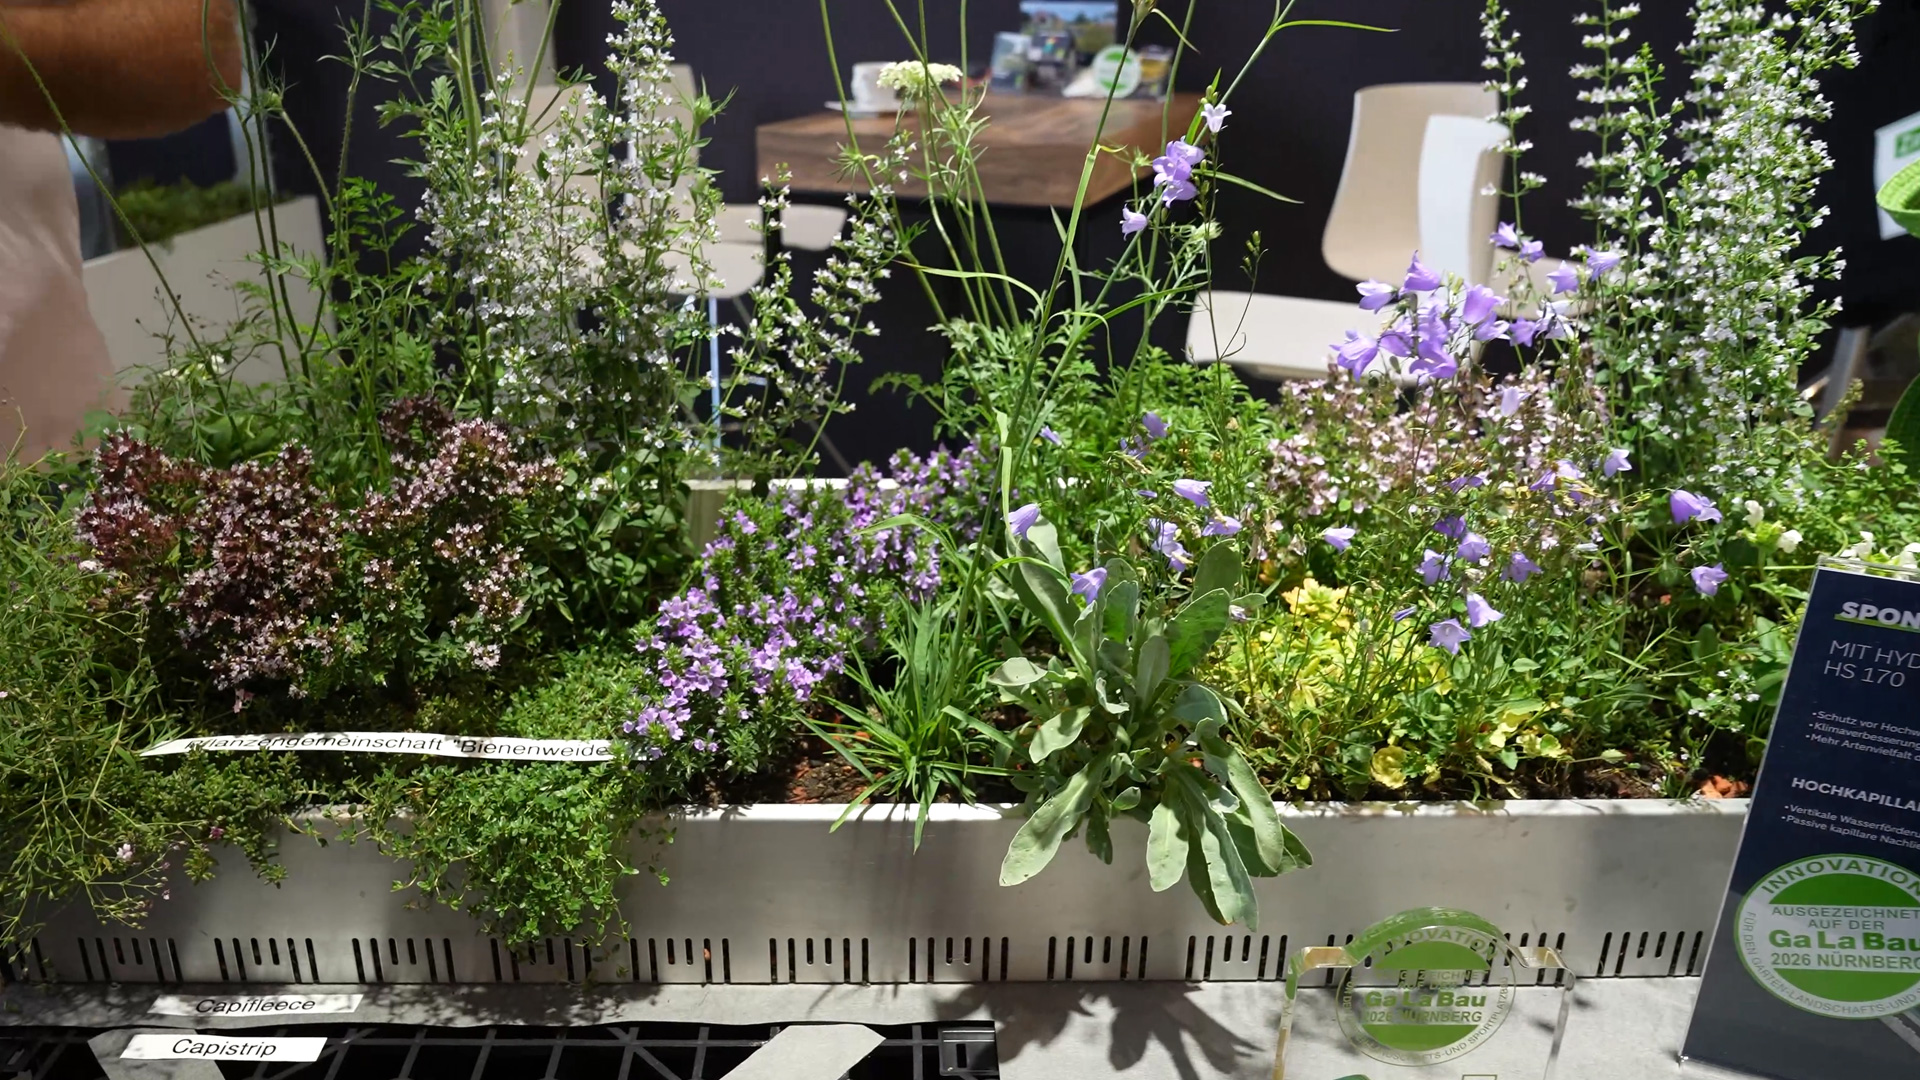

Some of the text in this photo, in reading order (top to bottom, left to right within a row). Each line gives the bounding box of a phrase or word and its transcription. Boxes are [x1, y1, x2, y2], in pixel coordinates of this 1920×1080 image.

[1841, 601, 1920, 629] SPON
[1829, 640, 1872, 660] MIT
[1824, 660, 1905, 687] HS 170
[1859, 719, 1878, 729] vor
[1841, 739, 1912, 760] Artenvielfalt
[1829, 823, 1877, 841] kapillare
[1742, 911, 1757, 932] FÜR
[1772, 906, 1920, 919] AUSGEZEICHNET
[1808, 919, 1885, 931] AUF DER
[1743, 934, 1757, 955] DEN
[1771, 952, 1811, 966] 2026
[195, 998, 316, 1015] Capifleece
[172, 1038, 277, 1058] Capistrip
